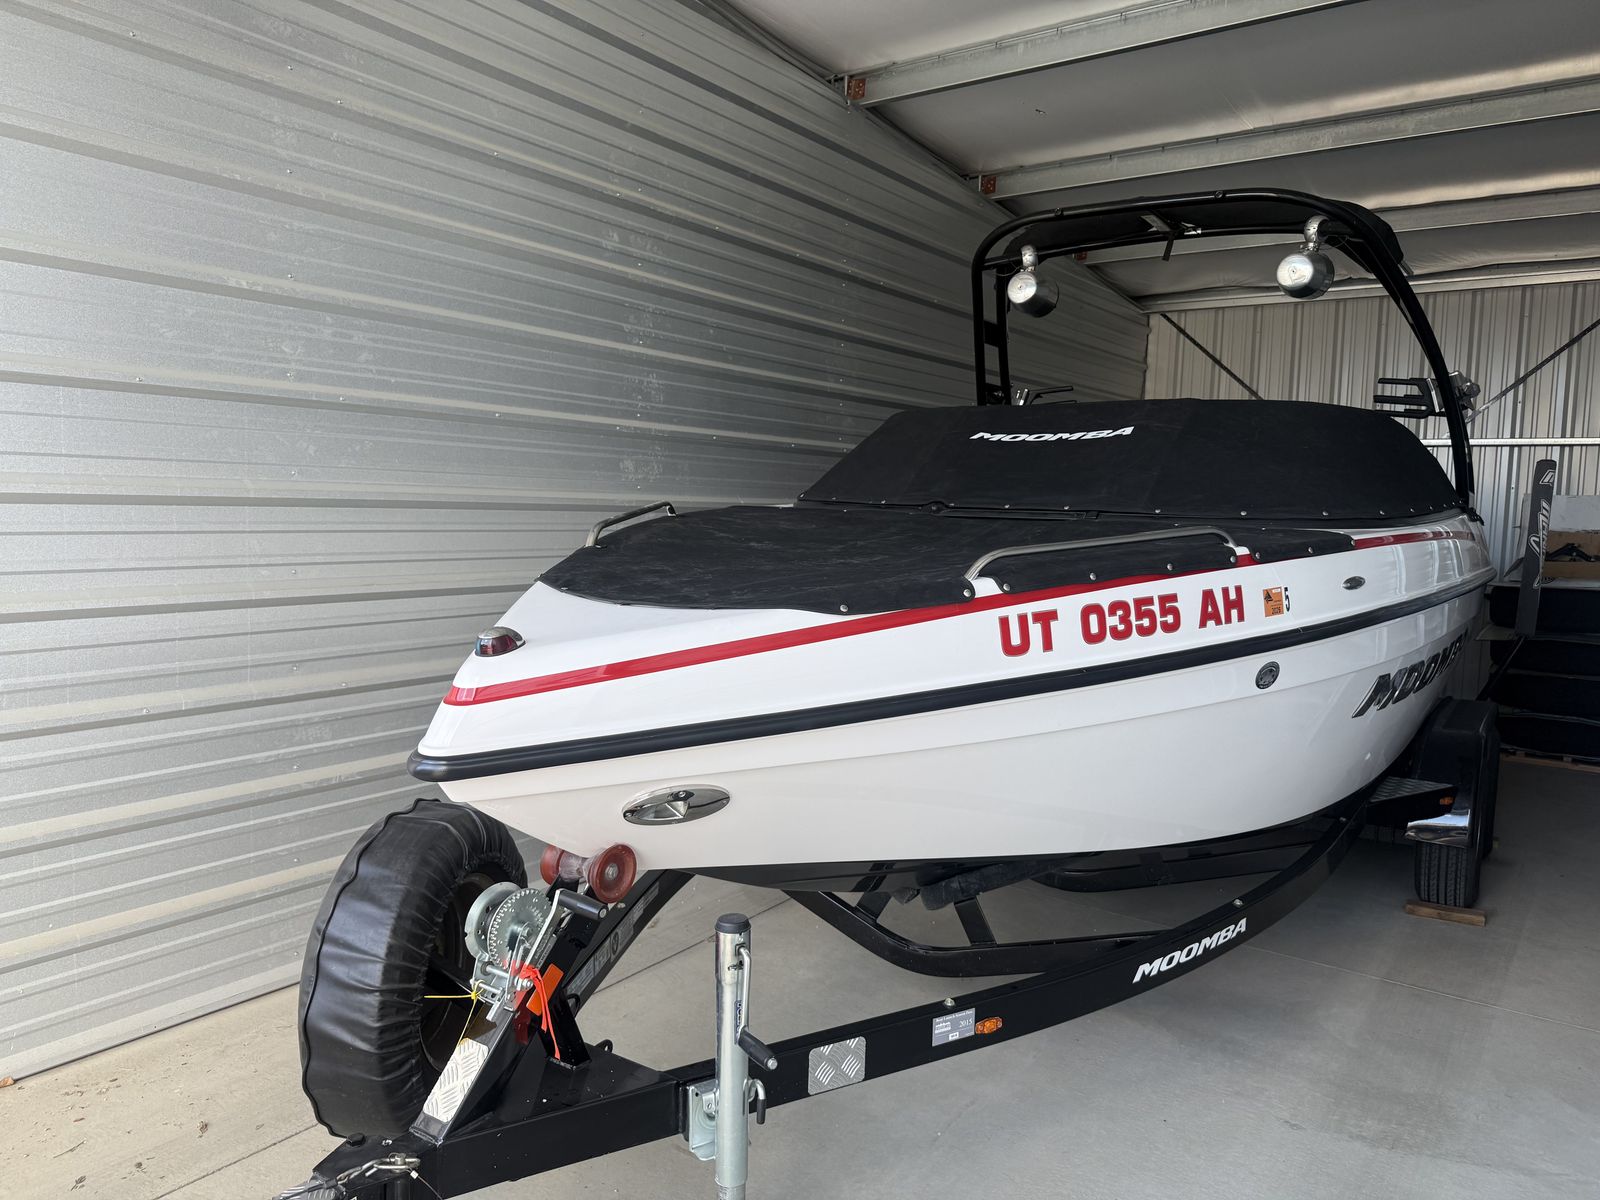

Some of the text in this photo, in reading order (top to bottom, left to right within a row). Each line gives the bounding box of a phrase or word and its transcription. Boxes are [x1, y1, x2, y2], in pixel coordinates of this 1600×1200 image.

[969, 426, 1135, 442] MOOMBA
[1284, 587, 1290, 612] 5
[998, 585, 1246, 658] UT 0355 AH
[1132, 917, 1247, 984] MOOMBA
[959, 1018, 973, 1028] 2015
